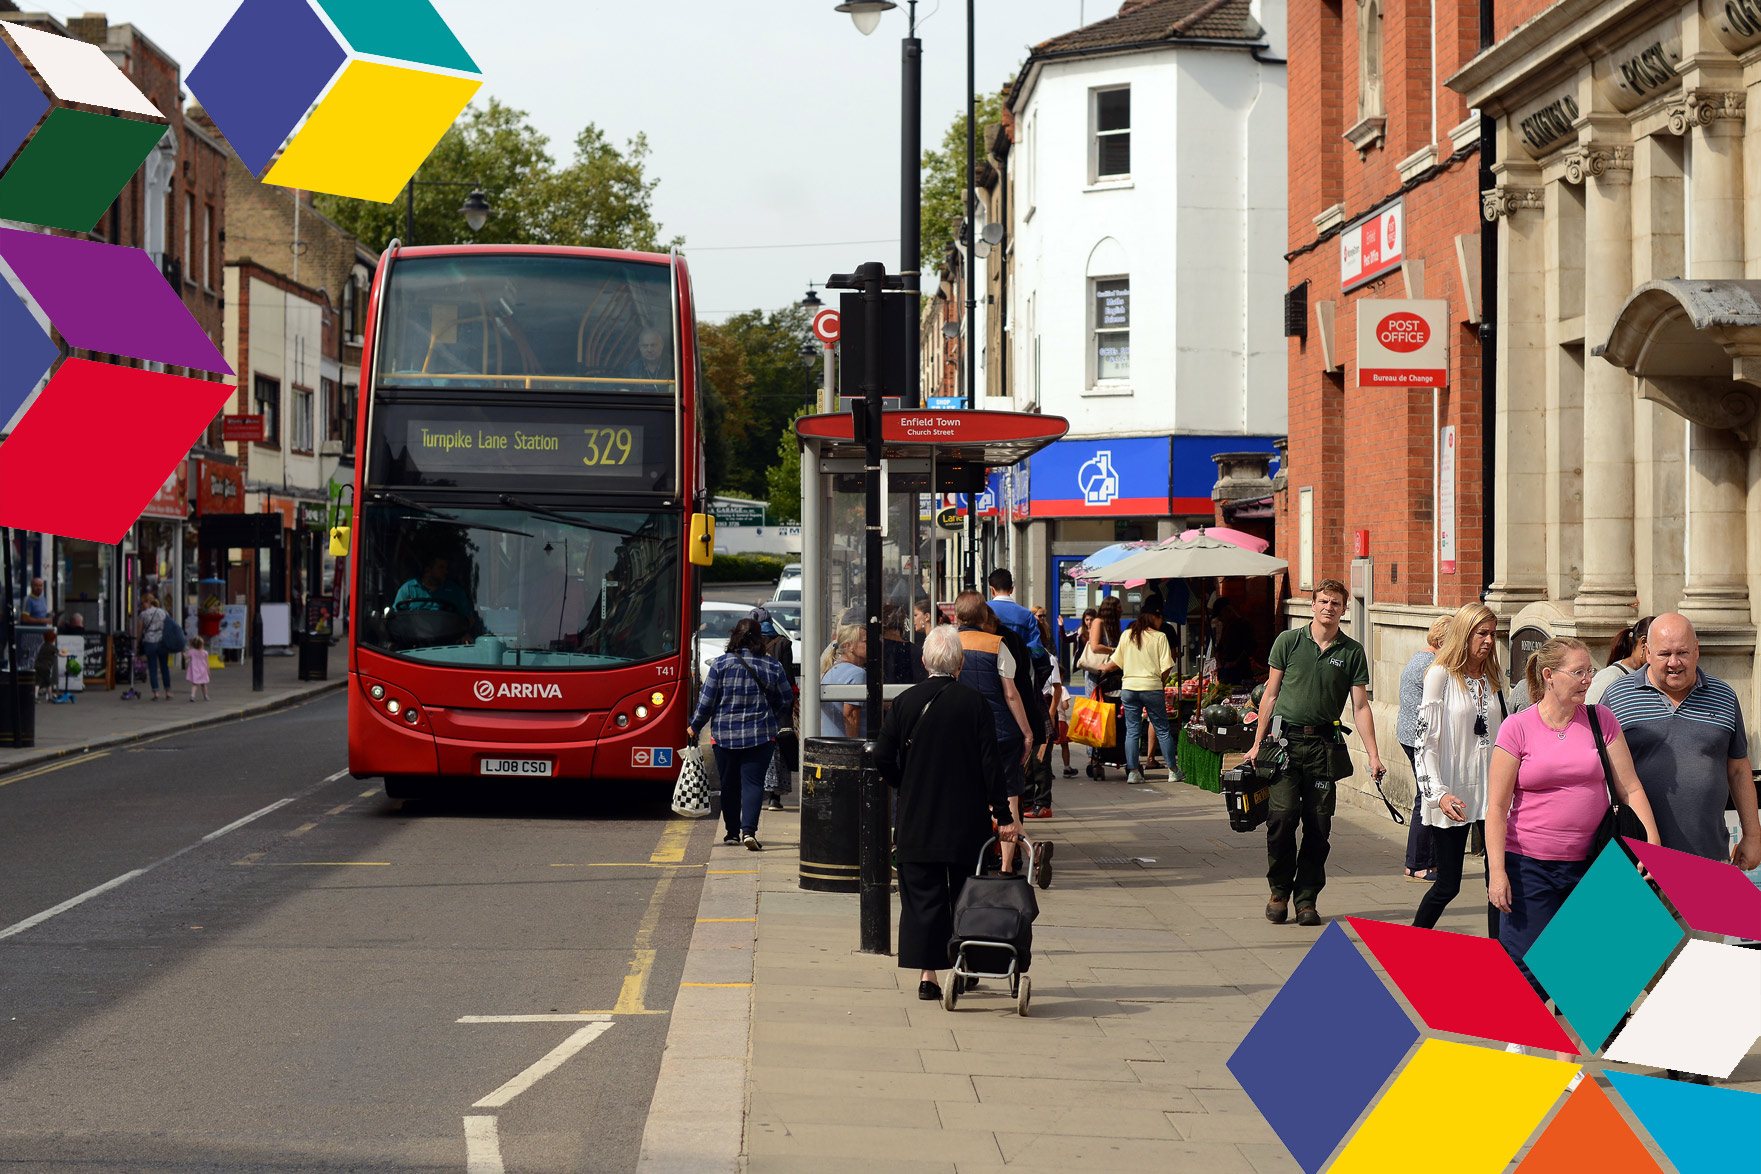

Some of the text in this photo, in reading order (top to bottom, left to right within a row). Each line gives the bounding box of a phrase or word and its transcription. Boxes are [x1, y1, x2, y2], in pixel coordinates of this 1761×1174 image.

[1618, 41, 1679, 96] POST
[1388, 320, 1420, 331] POST
[1381, 331, 1424, 343] OFFICE
[1373, 374, 1433, 383] Bureau de Change
[901, 417, 961, 427] Enfield Town
[907, 428, 954, 436] Church Street
[421, 428, 632, 466] Turnpike Lane Station 329
[655, 666, 675, 676] T41
[497, 683, 562, 698] ARRIVA
[485, 760, 547, 773] LJ08 CSO
